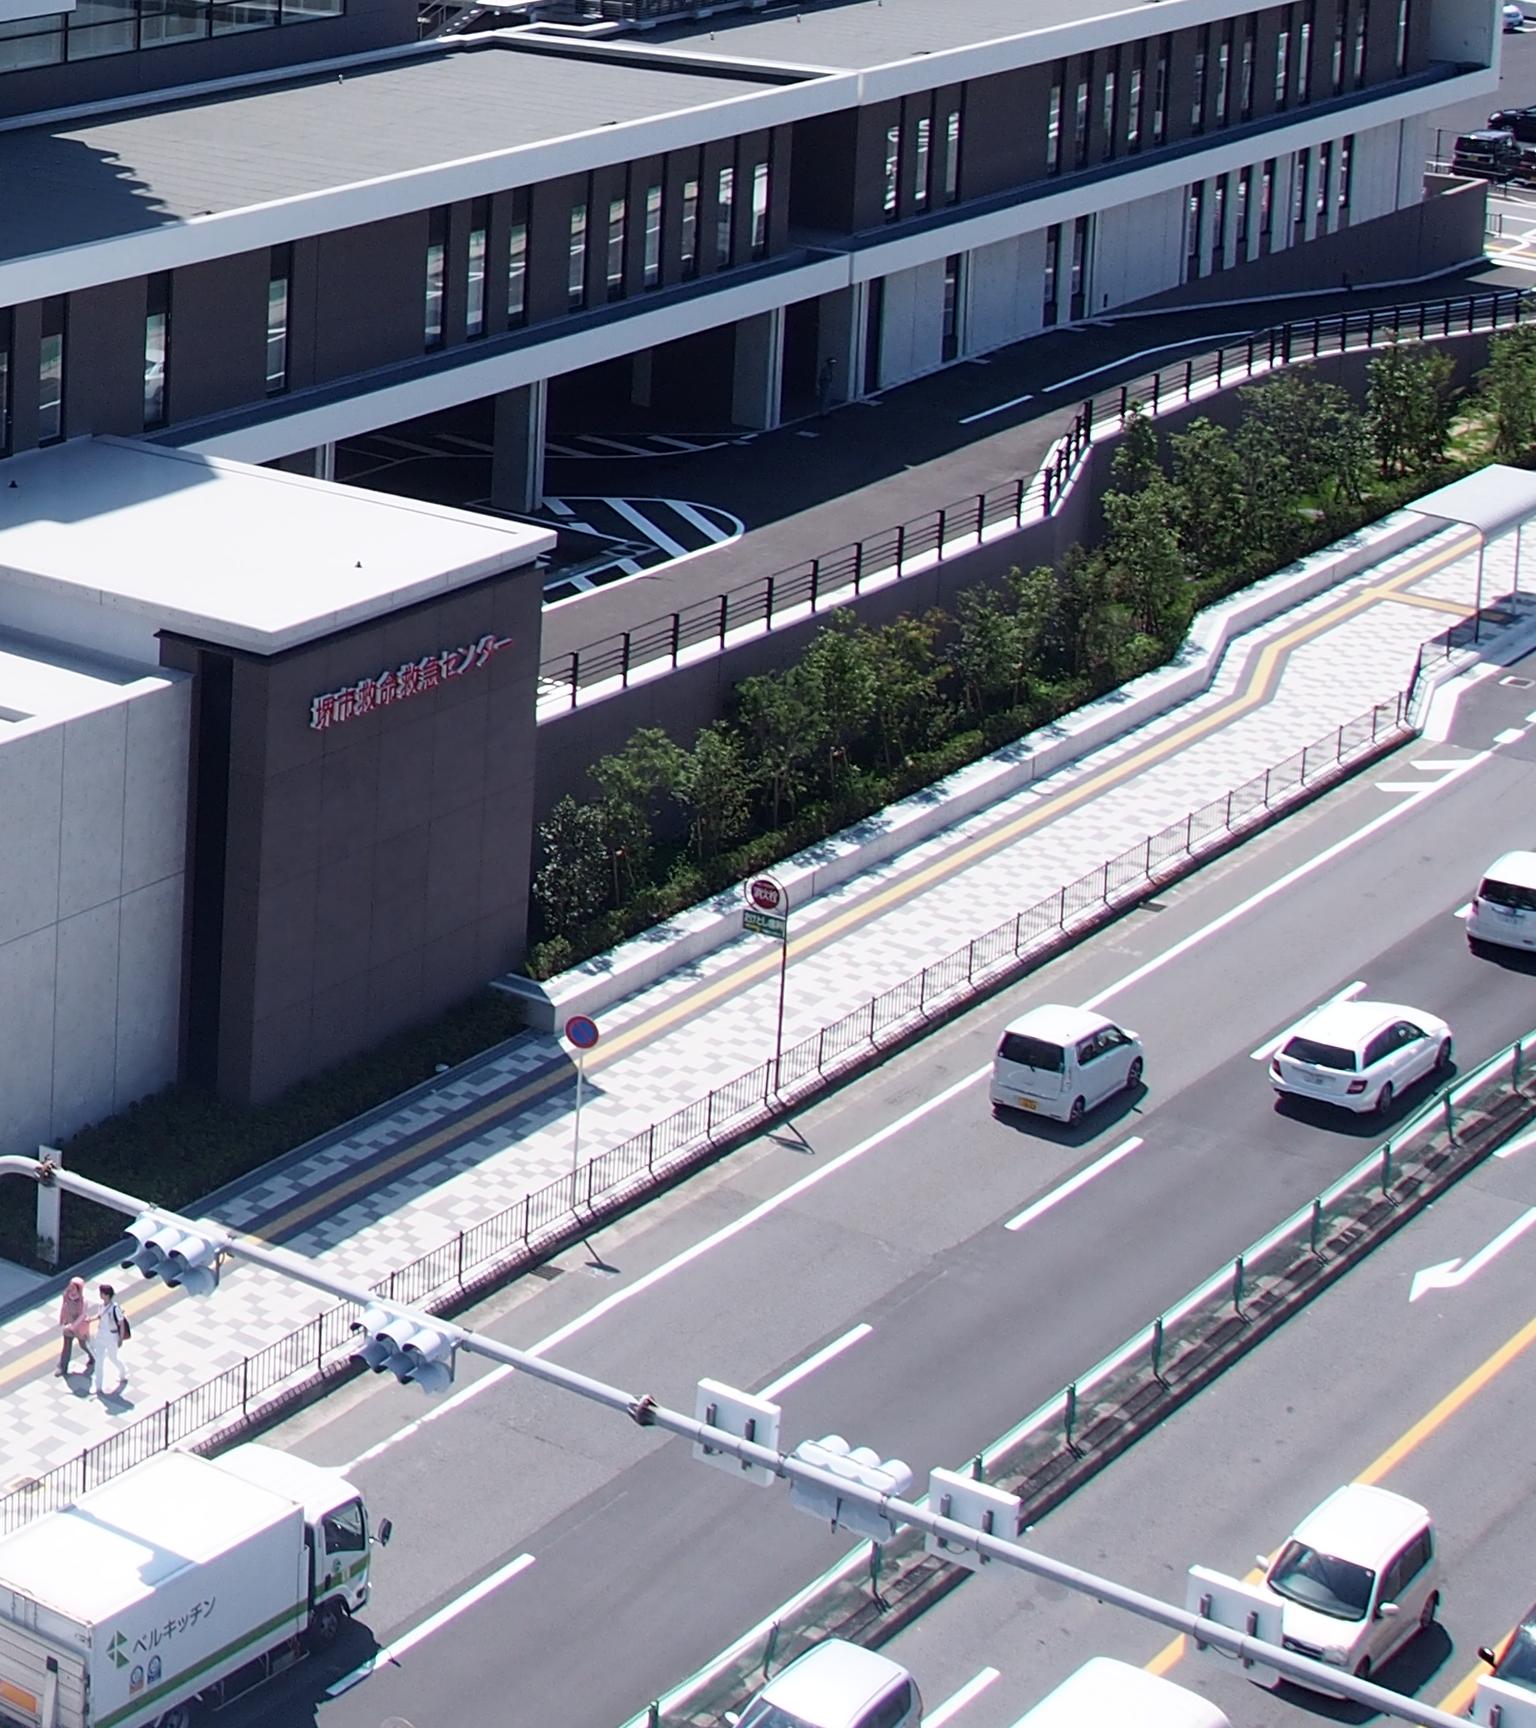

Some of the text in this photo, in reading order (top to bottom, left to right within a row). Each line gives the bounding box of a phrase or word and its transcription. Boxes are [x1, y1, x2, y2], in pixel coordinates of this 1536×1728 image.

[309, 634, 513, 731] 堺市救命救急センター
[132, 1596, 216, 1653] ベルキッチン
